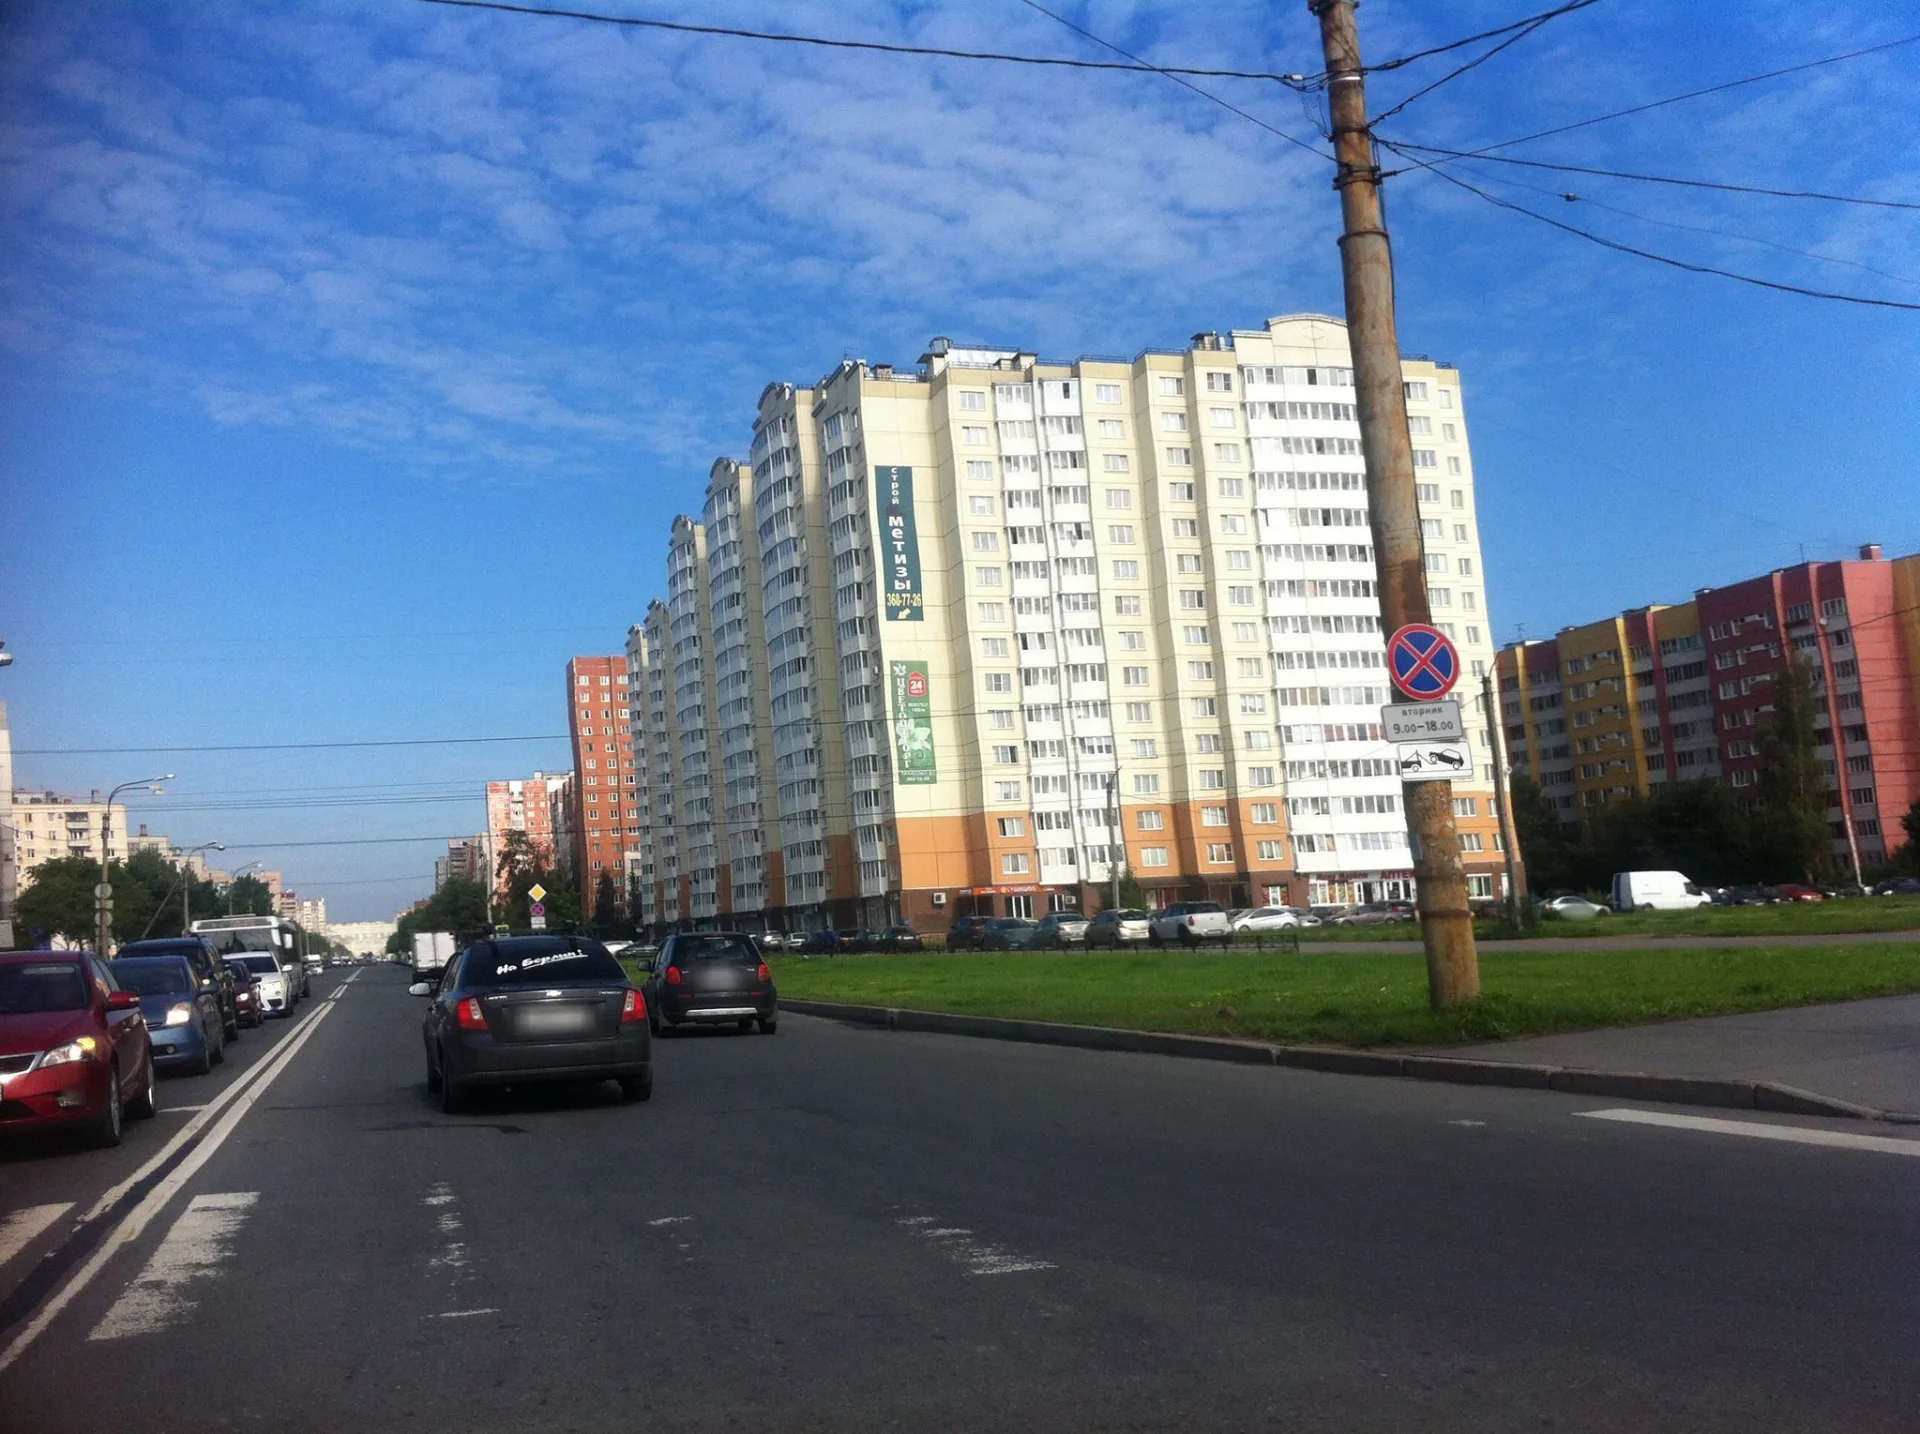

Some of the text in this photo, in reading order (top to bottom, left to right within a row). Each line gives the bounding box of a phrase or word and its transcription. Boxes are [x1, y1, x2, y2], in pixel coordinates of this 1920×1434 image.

[888, 516, 911, 590] метизы
[911, 680, 923, 690] 24
[1402, 707, 1444, 717] вторник
